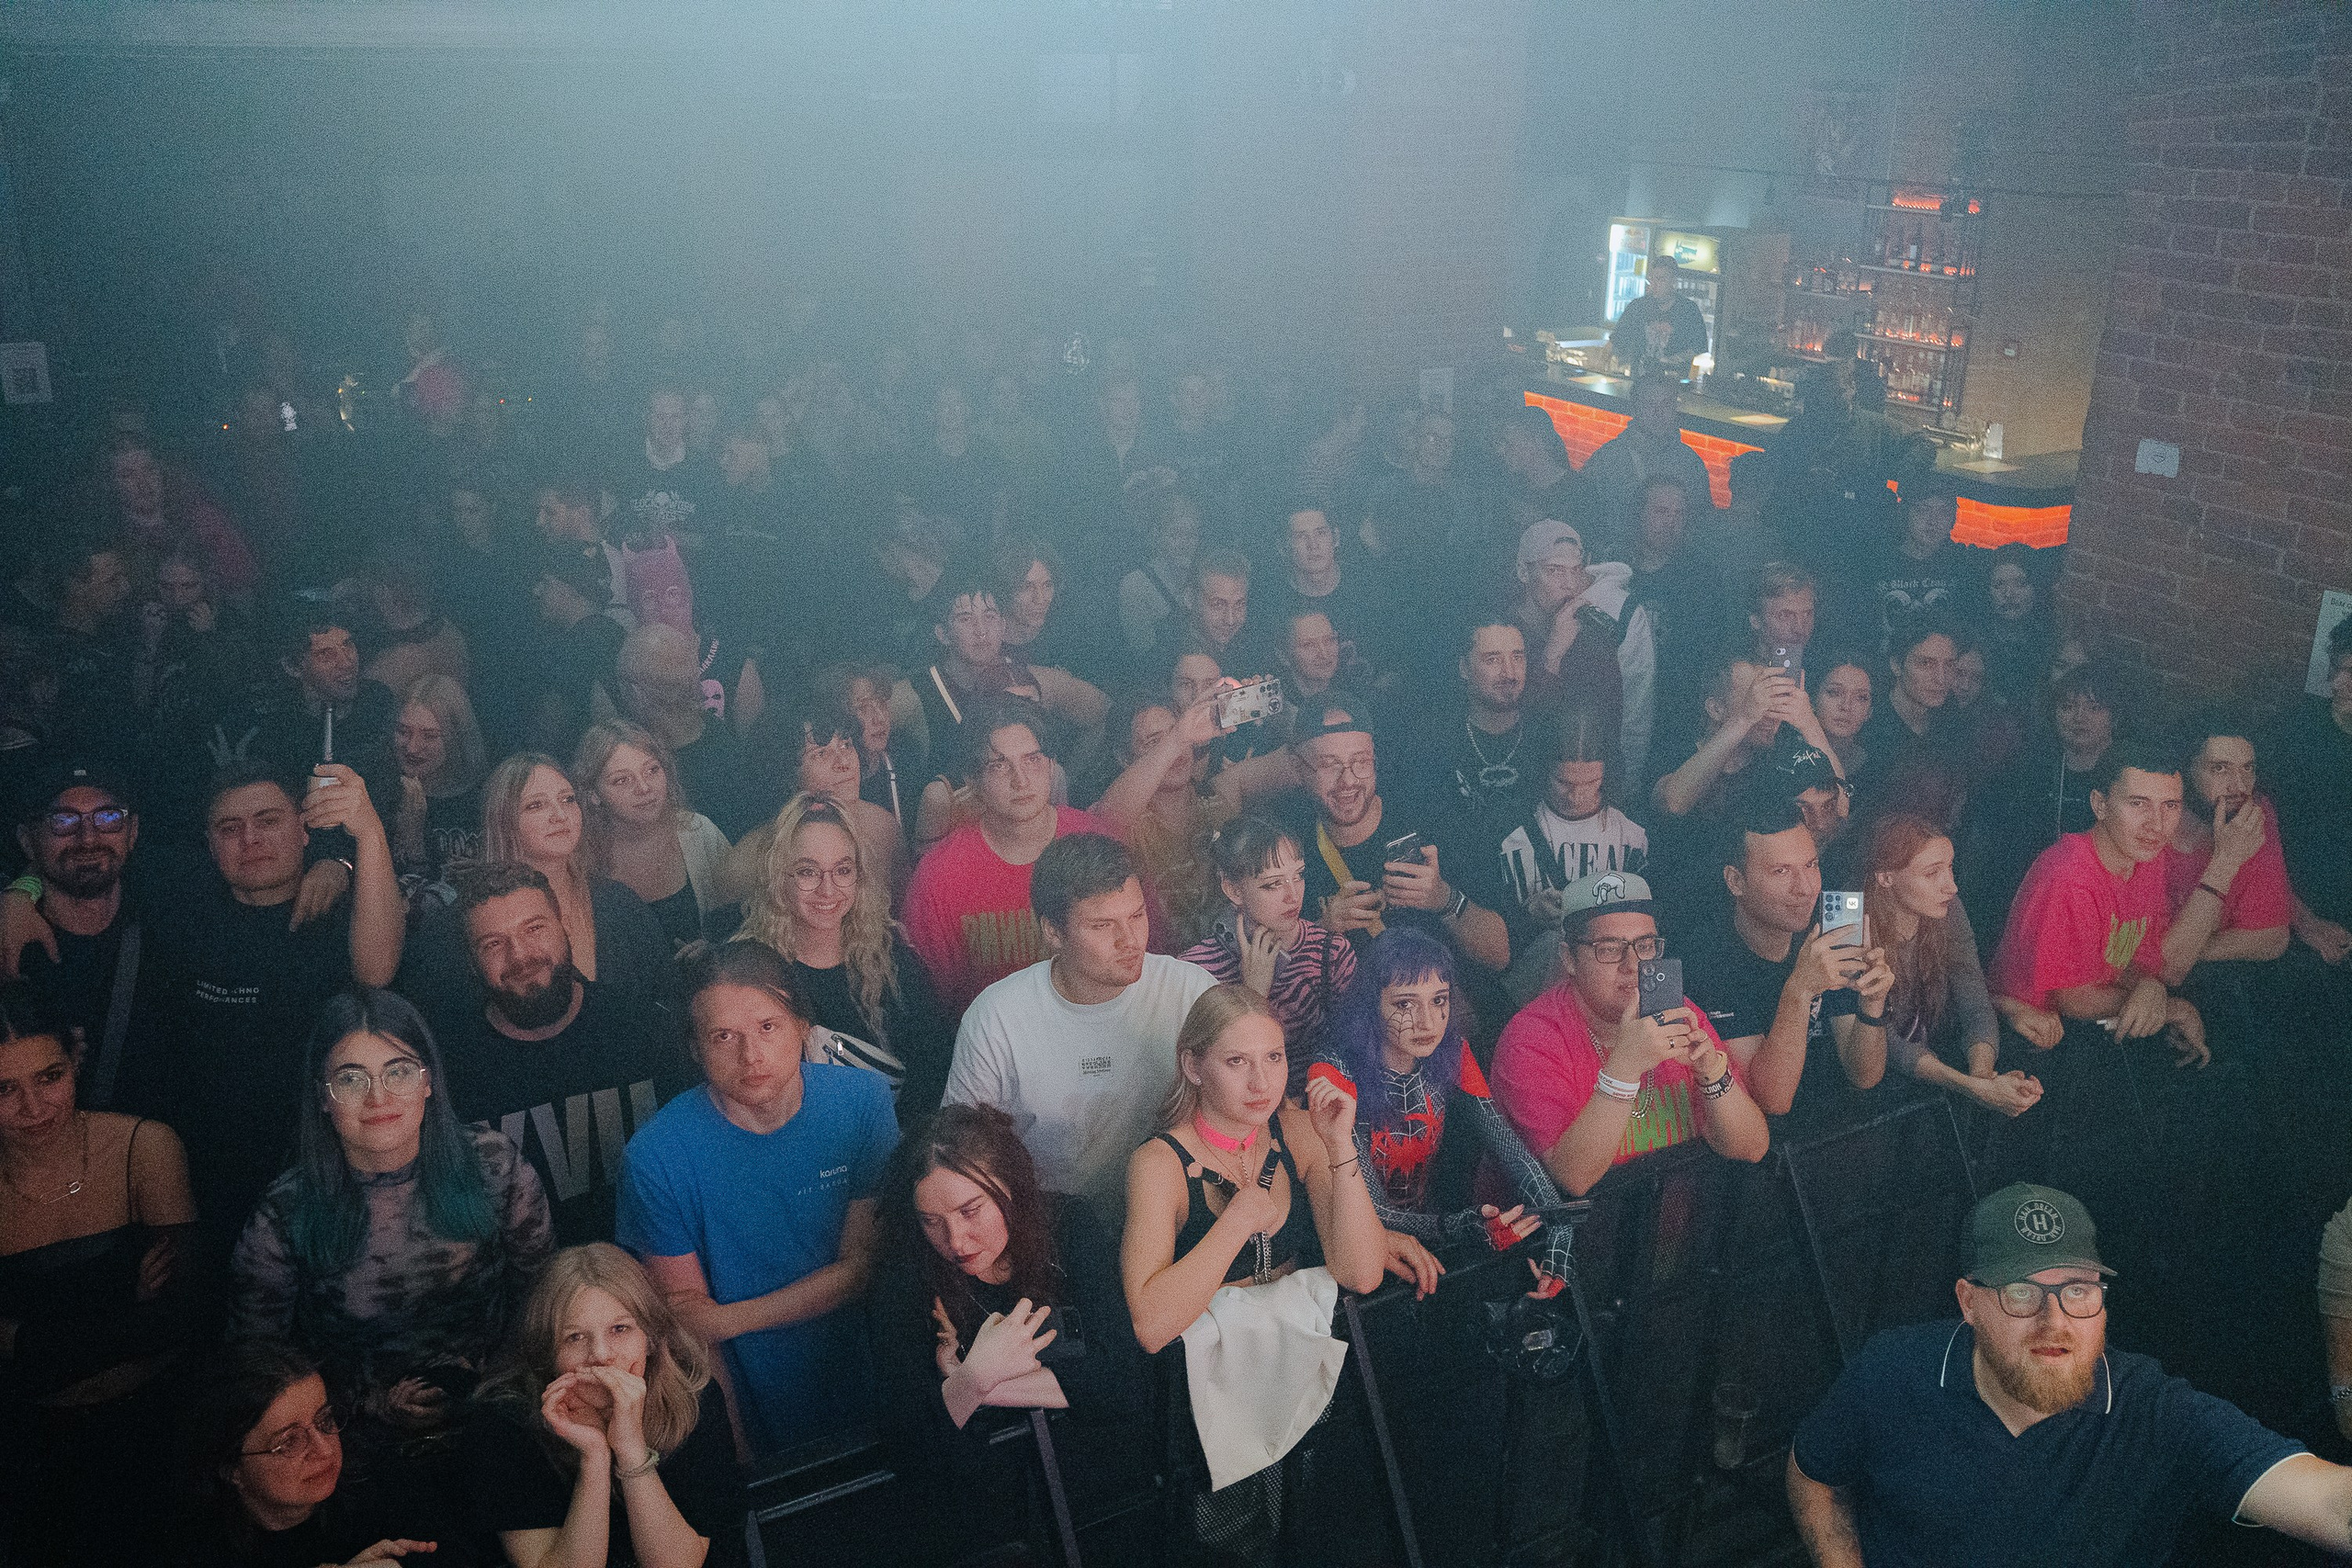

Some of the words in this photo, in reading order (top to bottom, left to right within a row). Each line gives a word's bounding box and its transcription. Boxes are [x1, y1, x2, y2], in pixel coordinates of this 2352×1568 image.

[196, 979, 228, 995] LIMITED
[231, 987, 260, 995] CHNO
[196, 989, 257, 1003] PERFOANCES
[2032, 1213, 2049, 1231] H
